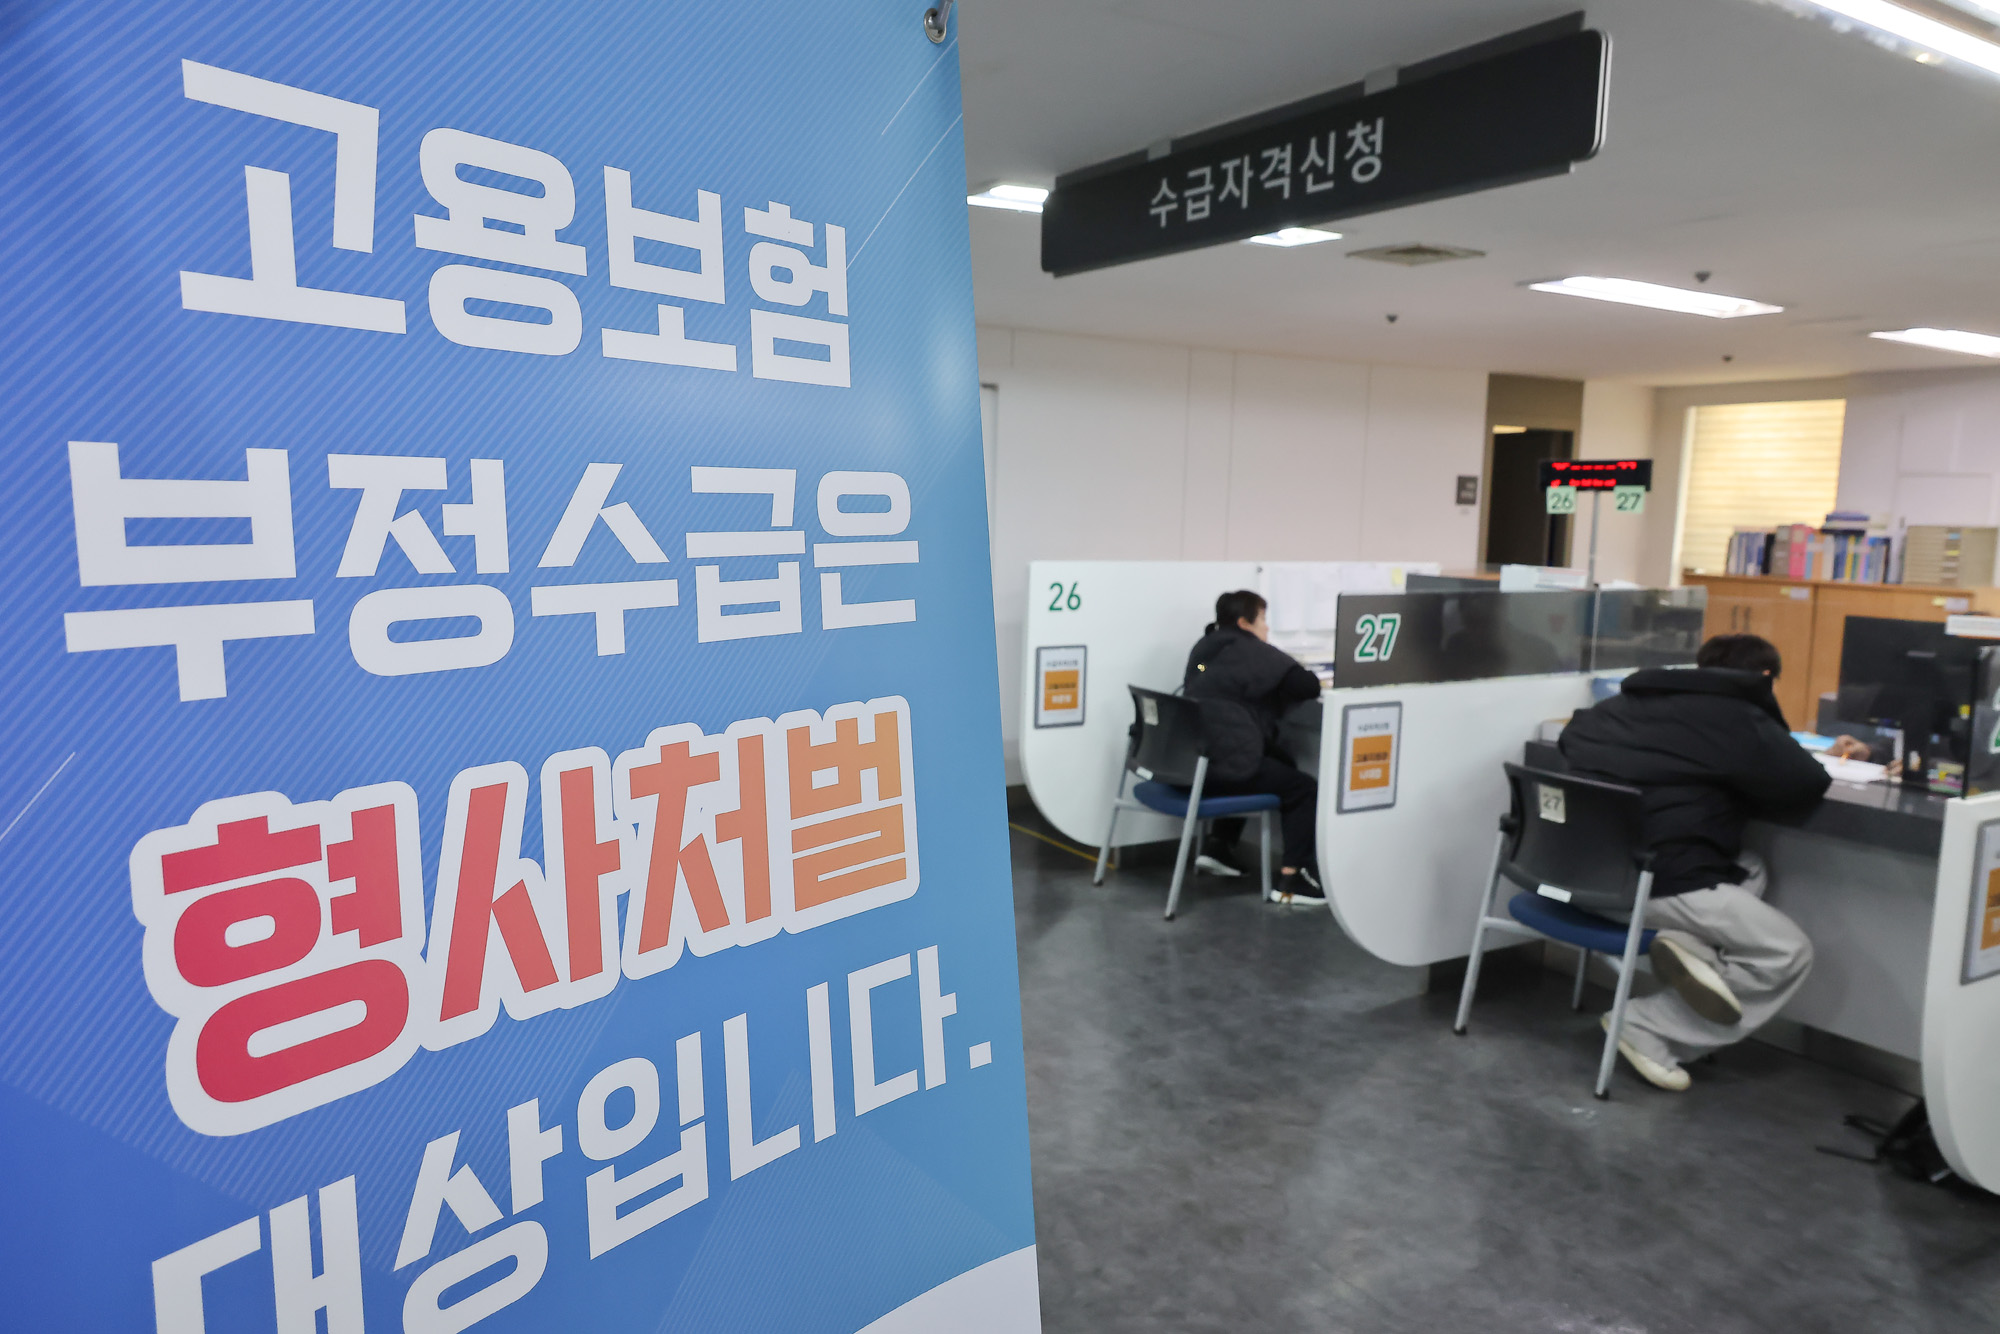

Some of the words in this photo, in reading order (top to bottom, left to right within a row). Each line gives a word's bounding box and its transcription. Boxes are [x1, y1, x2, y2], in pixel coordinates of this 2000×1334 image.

[1150, 117, 1384, 228] 수급자격신청
[180, 58, 852, 388] 고용보험
[1551, 492, 1574, 511] 26
[1615, 492, 1641, 512] 27
[64, 440, 919, 702] 부정수급은
[1048, 581, 1081, 611] 26
[1357, 615, 1399, 660] 27
[157, 708, 911, 1106] 형사처벌
